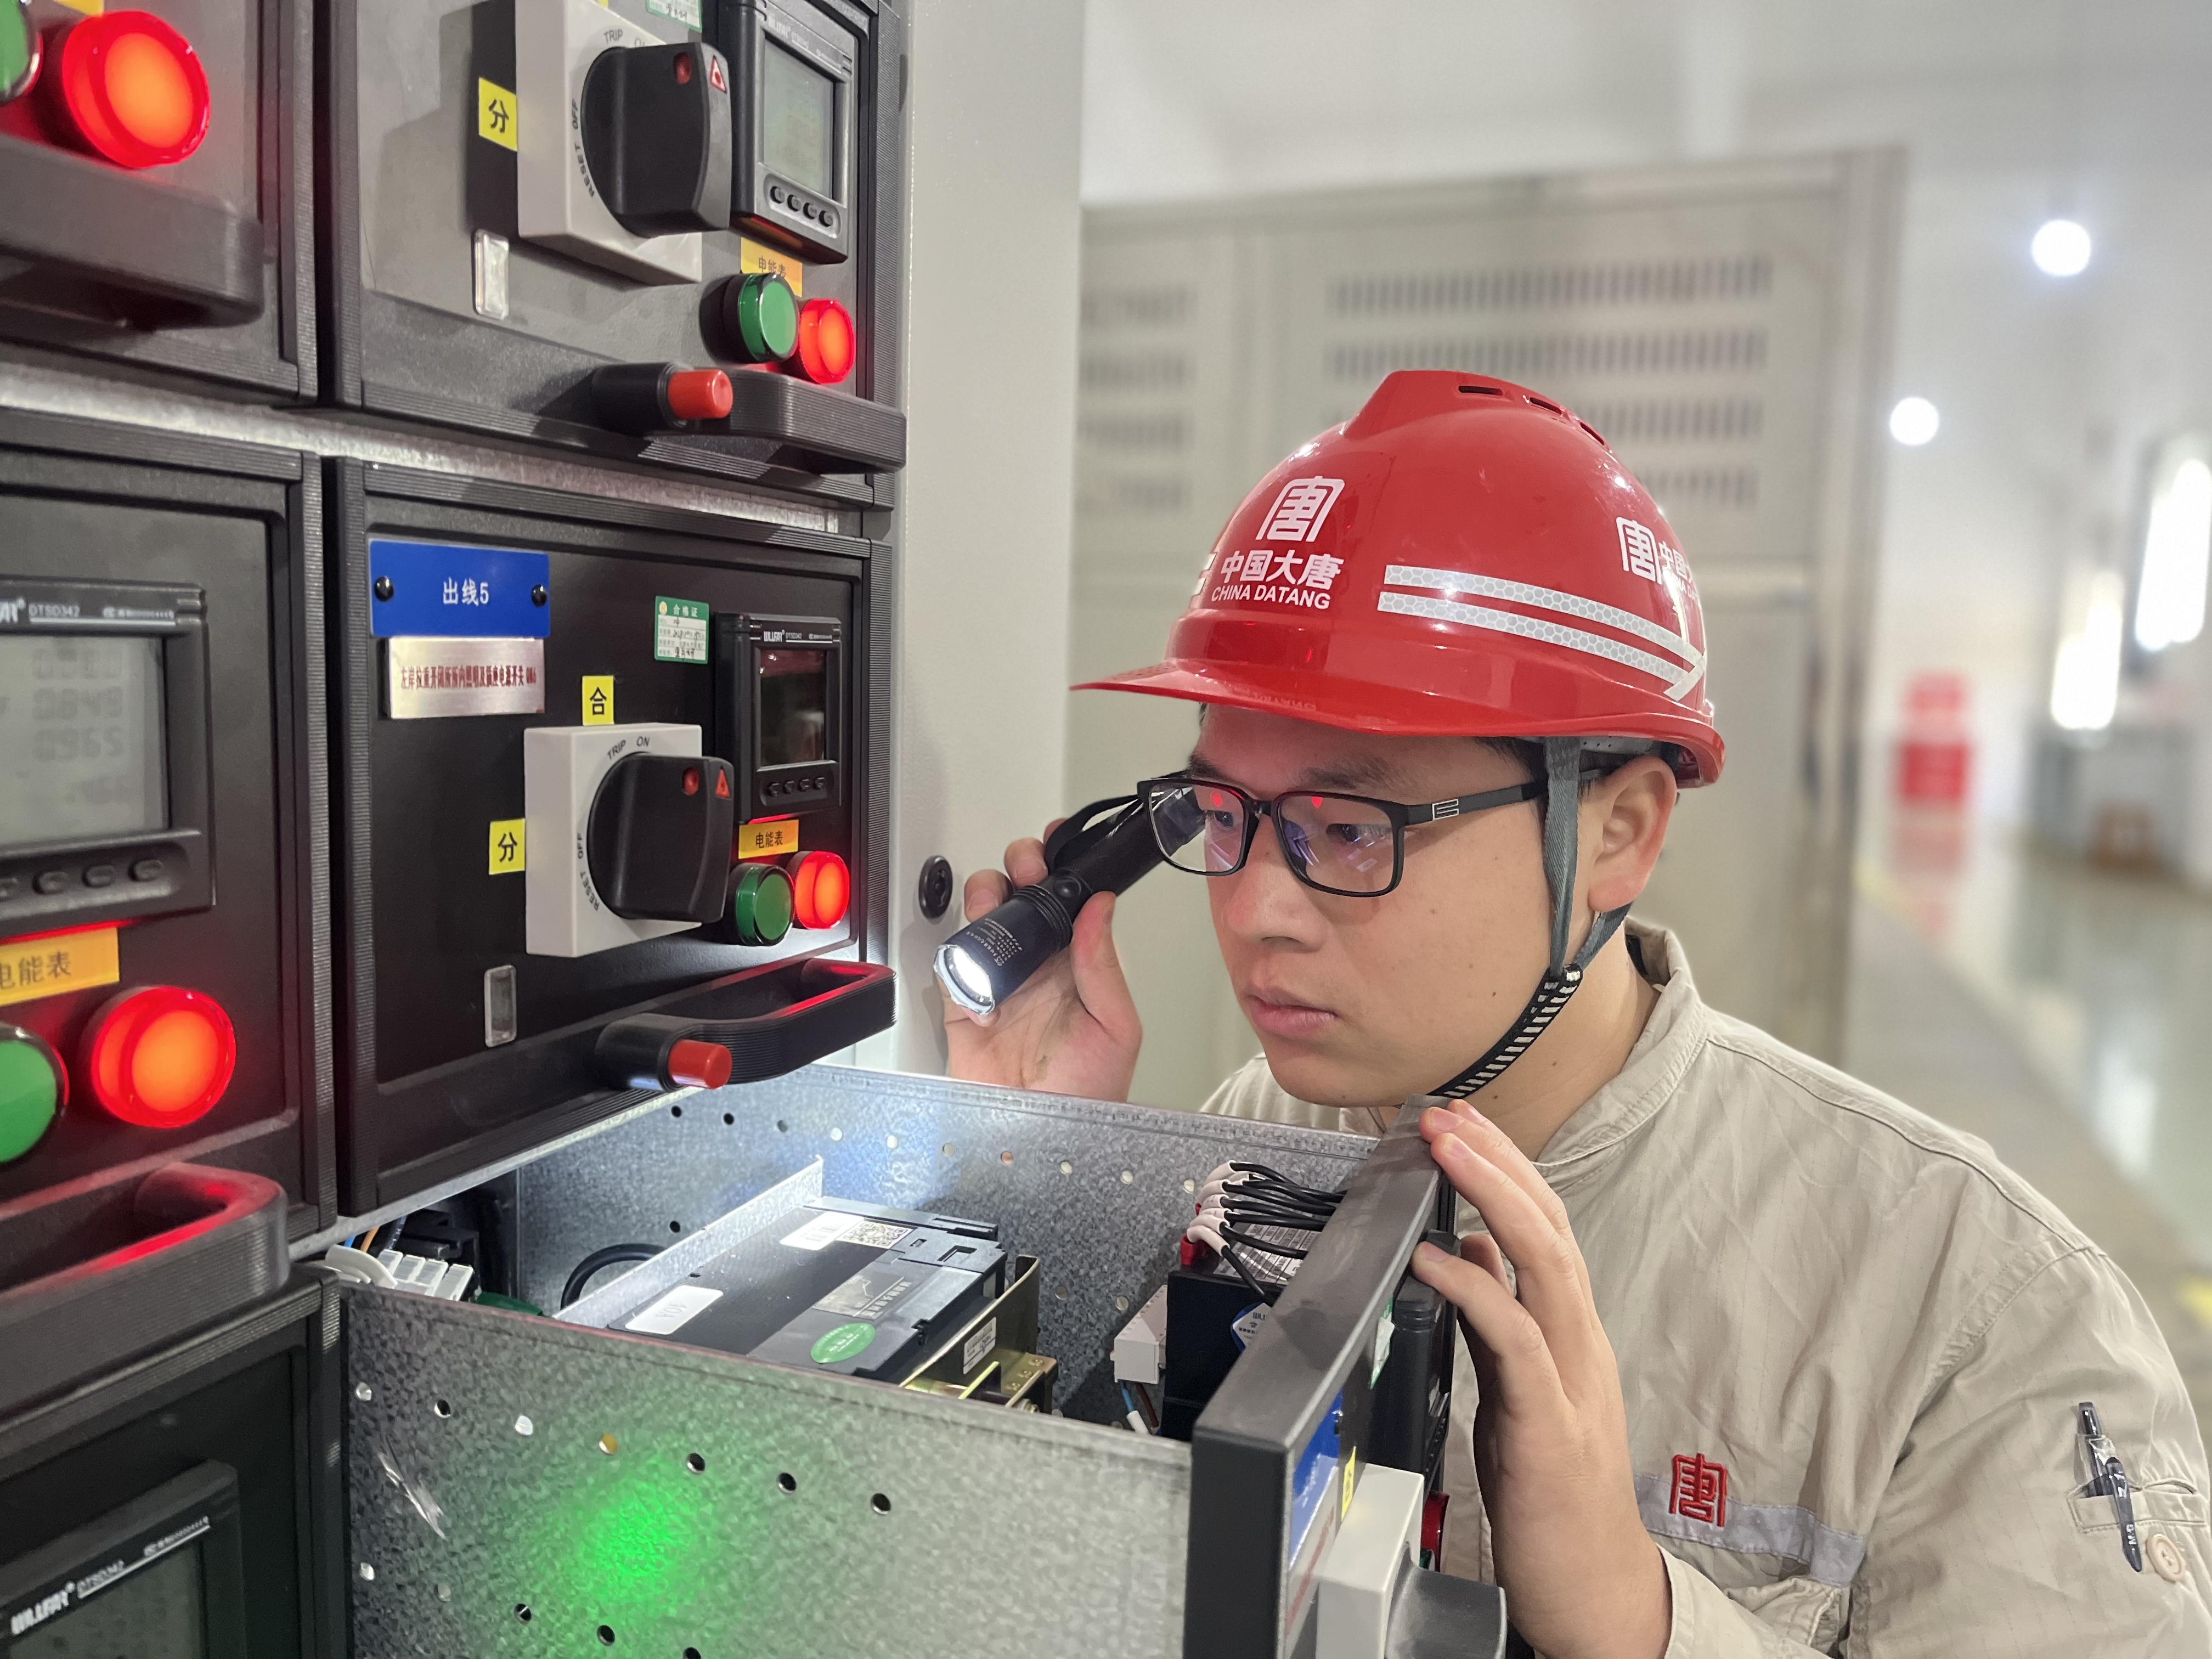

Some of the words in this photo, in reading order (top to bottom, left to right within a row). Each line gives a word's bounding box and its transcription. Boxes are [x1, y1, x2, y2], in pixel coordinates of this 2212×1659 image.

[603, 29, 624, 44] TRIP
[488, 99, 509, 133] 分
[574, 143, 596, 198] RESET
[1221, 549, 1345, 590] 中国大唐
[443, 576, 489, 606] 出线5
[1211, 584, 1251, 602] CHINA
[1254, 585, 1331, 610] DATANG
[589, 685, 607, 715] 合
[607, 740, 627, 760] TRIP
[636, 736, 650, 748] ON
[498, 832, 518, 863] 分
[755, 830, 783, 849] 电能表
[580, 870, 600, 911] RESET
